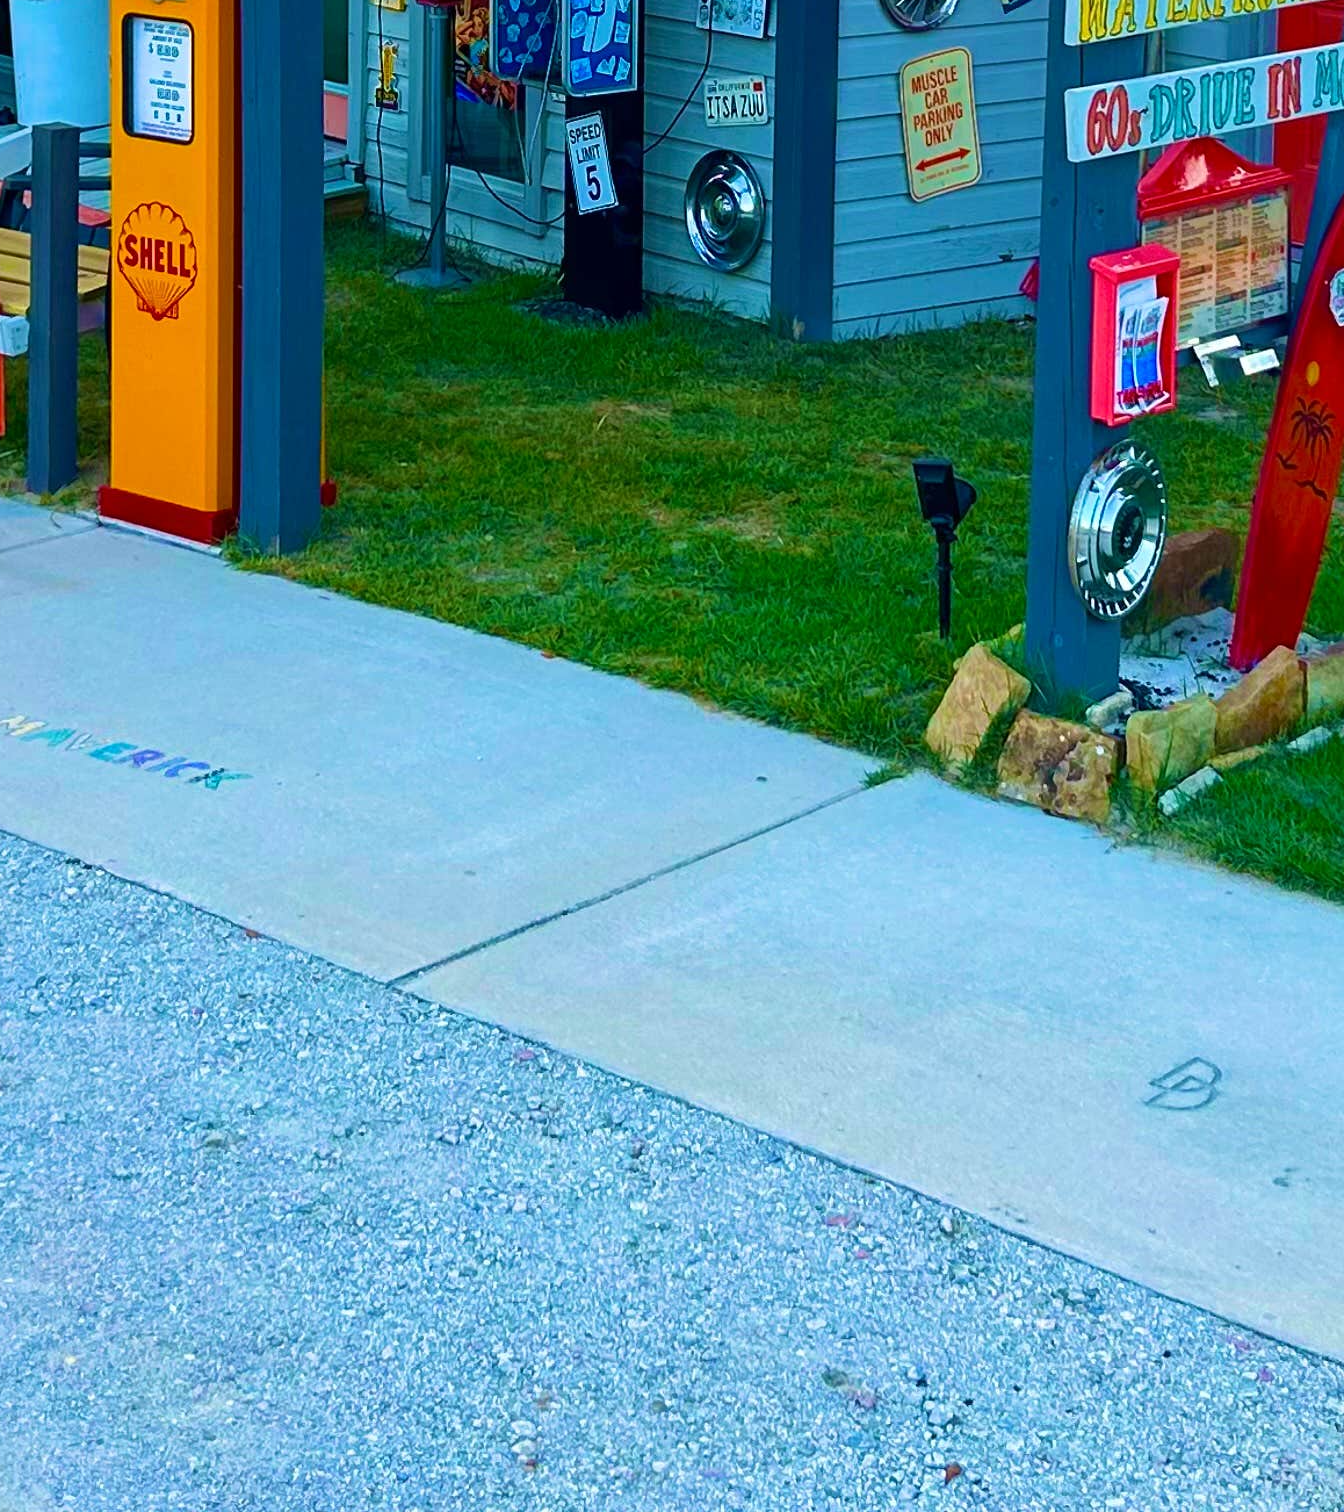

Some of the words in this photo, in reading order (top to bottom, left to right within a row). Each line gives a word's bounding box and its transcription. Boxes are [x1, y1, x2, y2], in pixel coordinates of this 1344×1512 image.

[911, 65, 958, 94] MUSCLE
[1266, 55, 1303, 120] IN
[924, 88, 949, 110] CAR
[913, 102, 964, 133] PARKING
[569, 123, 601, 145] SPEED
[924, 123, 954, 147] ONLY
[576, 144, 601, 165] LIMIT
[585, 165, 602, 201] 5
[124, 233, 191, 278] SHELL
